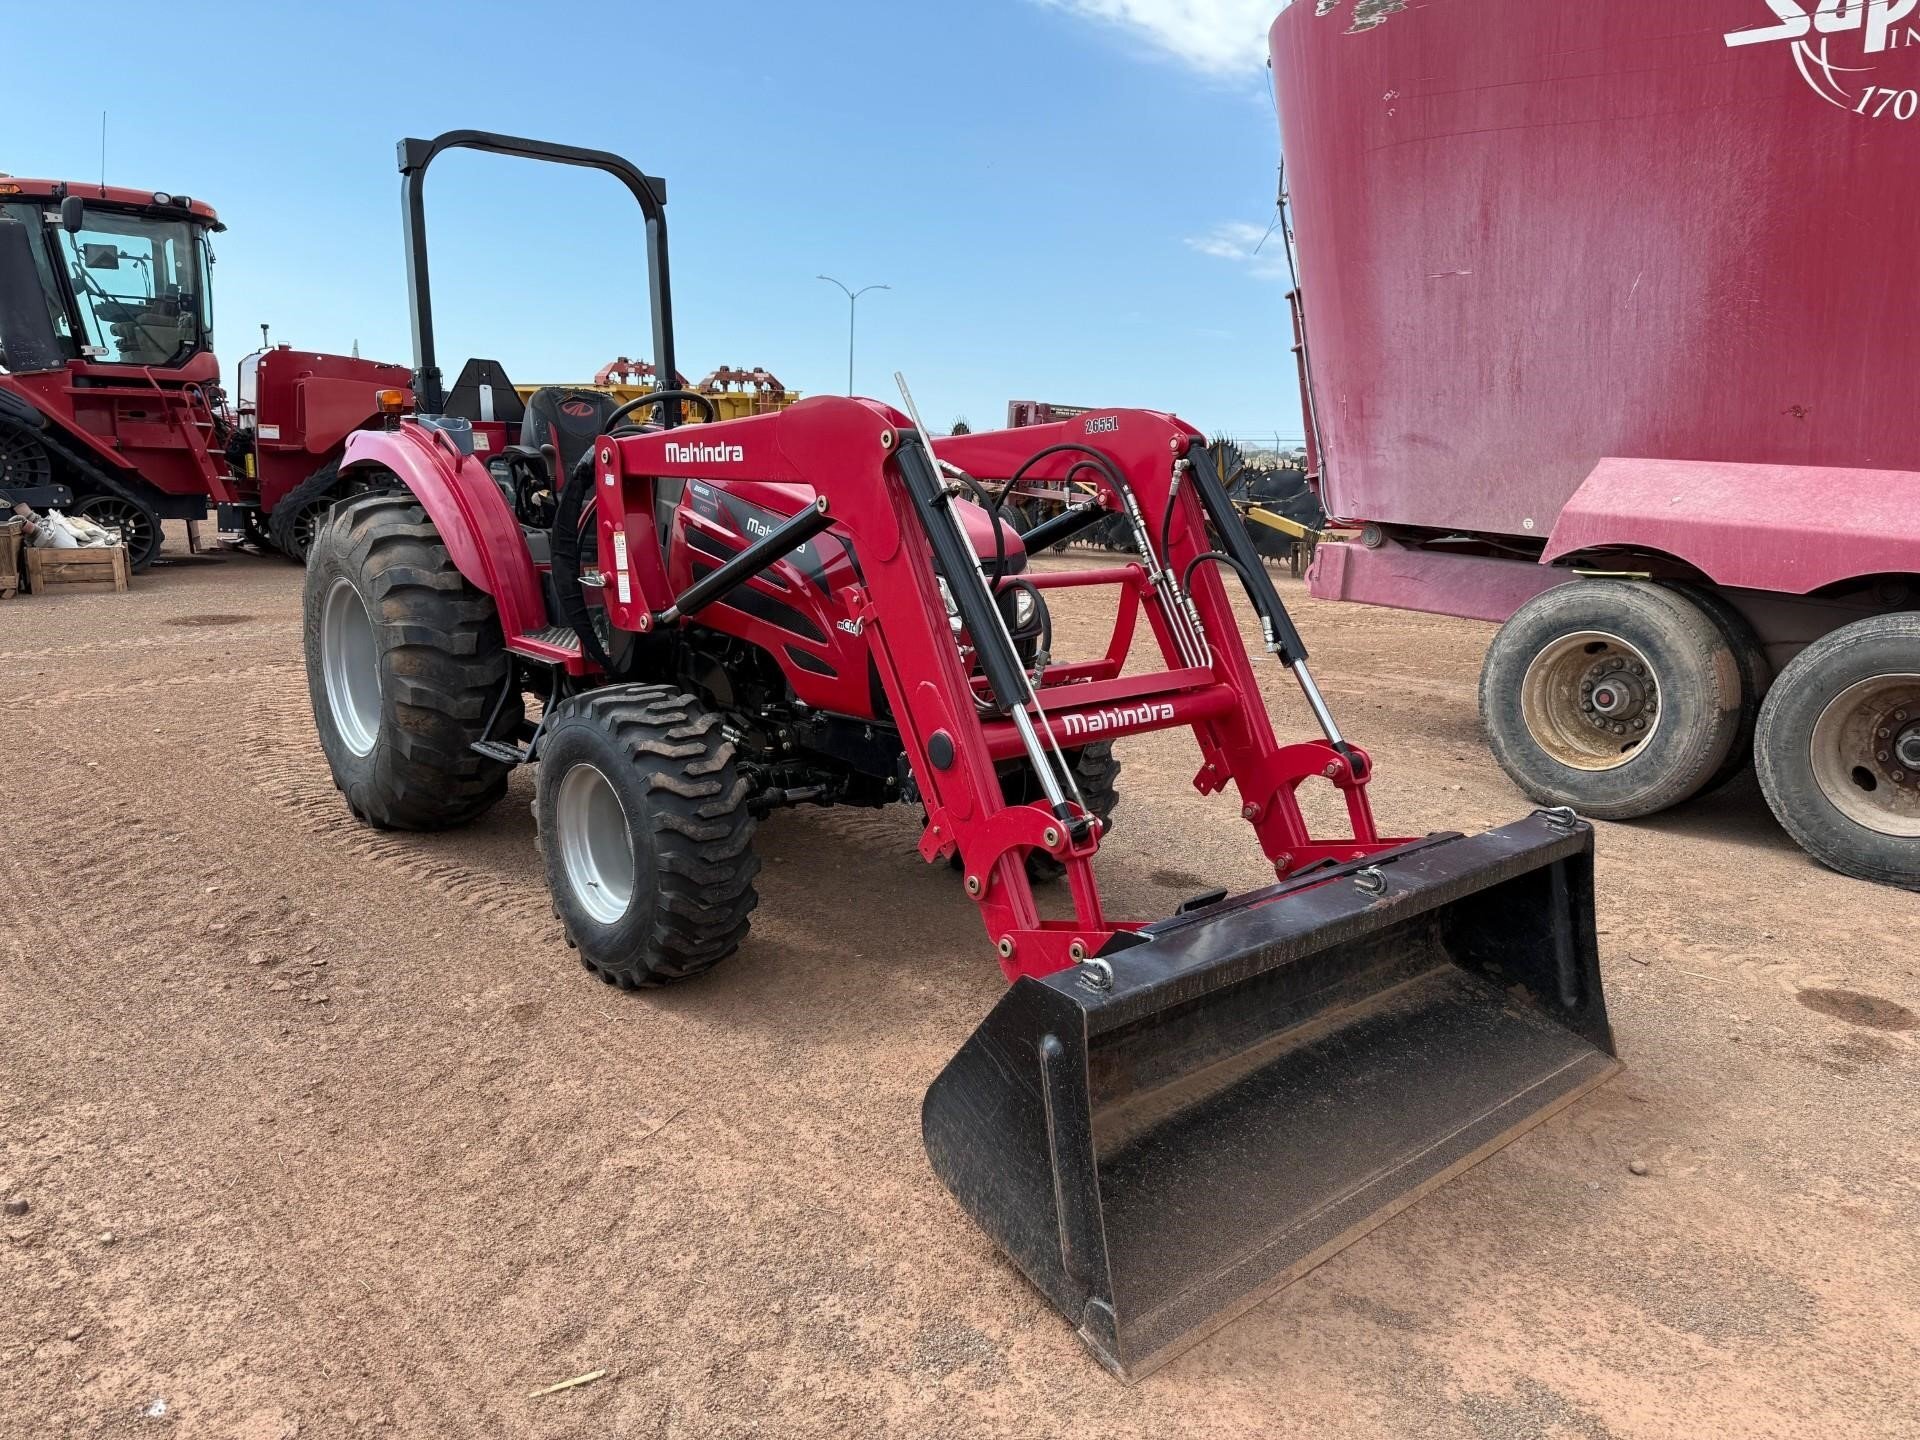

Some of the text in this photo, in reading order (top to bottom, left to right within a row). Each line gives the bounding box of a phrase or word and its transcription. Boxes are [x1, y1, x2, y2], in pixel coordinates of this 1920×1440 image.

[1086, 416, 1118, 434] 2655L
[665, 441, 743, 463] Mahindra
[1061, 702, 1174, 736] Mahindra
